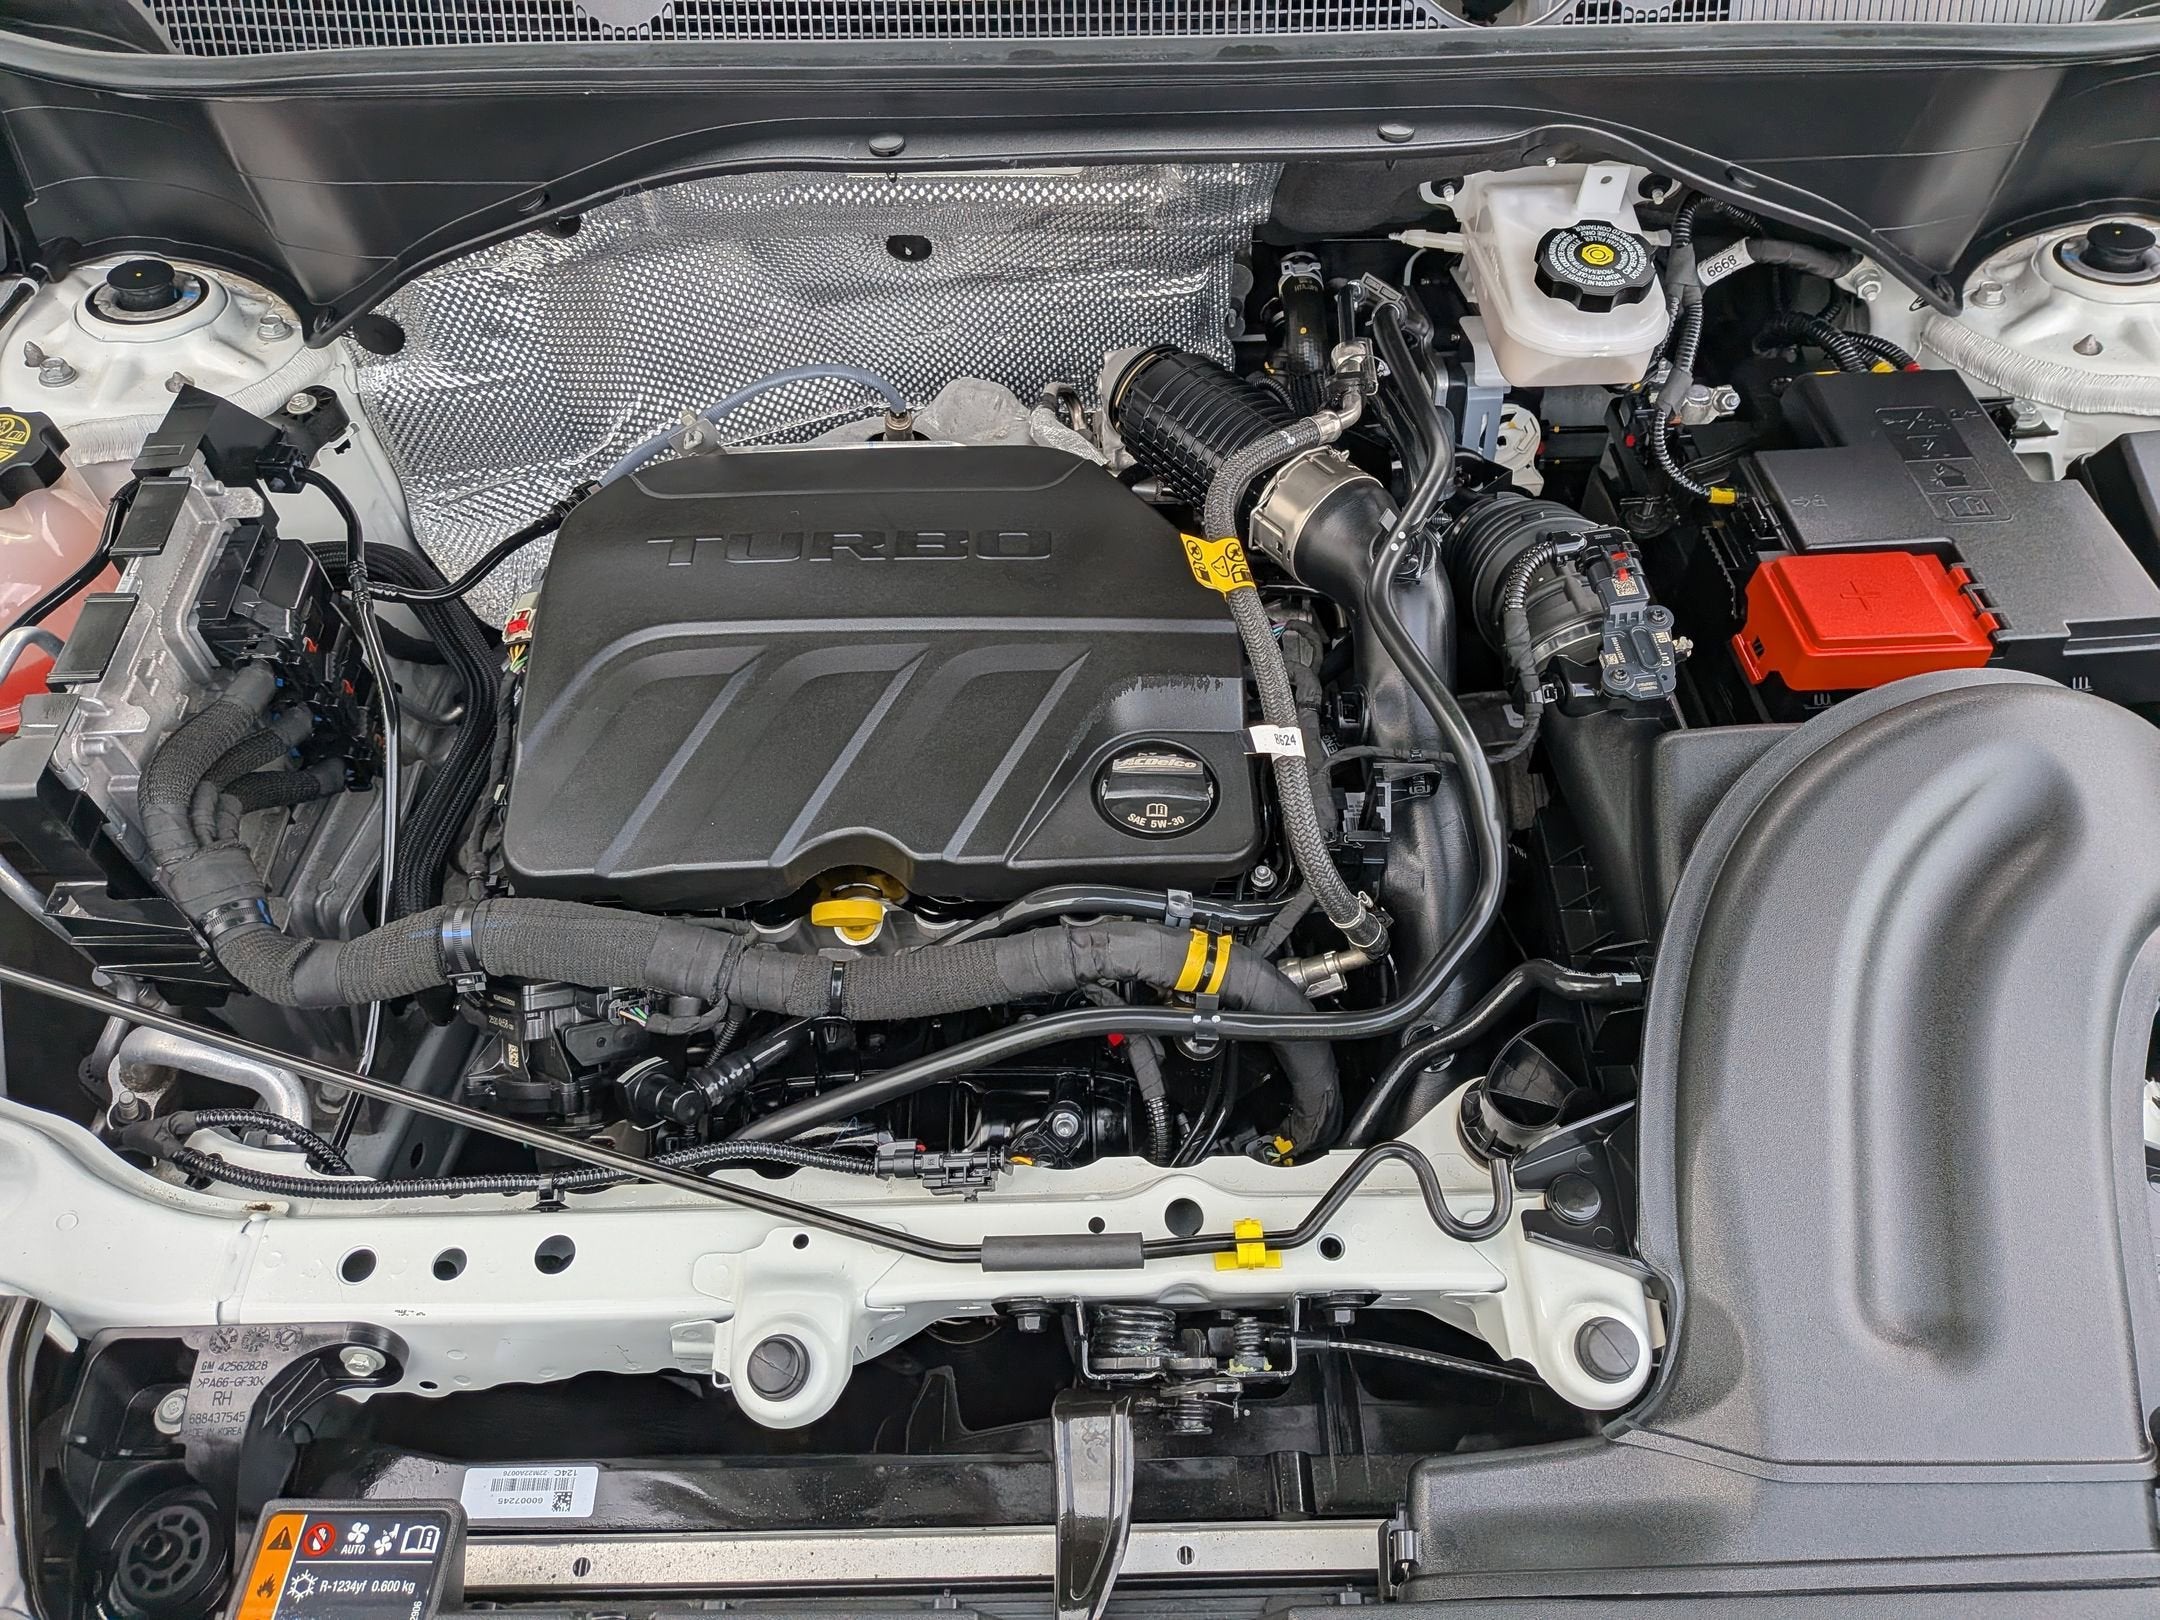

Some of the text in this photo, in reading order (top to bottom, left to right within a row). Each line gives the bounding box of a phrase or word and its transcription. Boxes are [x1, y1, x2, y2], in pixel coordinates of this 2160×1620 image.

[1707, 255, 1737, 277] 6668
[648, 530, 1051, 566] TURBO
[1119, 758, 1197, 768] ACDelco
[1128, 814, 1185, 828] SAE 5W-30
[201, 1361, 268, 1372] GM 42562828
[212, 1391, 233, 1406] RH
[189, 1411, 246, 1424] 688437545
[554, 1469, 578, 1477] 124C
[340, 1545, 366, 1555] AUTO
[319, 1580, 416, 1594] R-1234yf 0.600 kg
